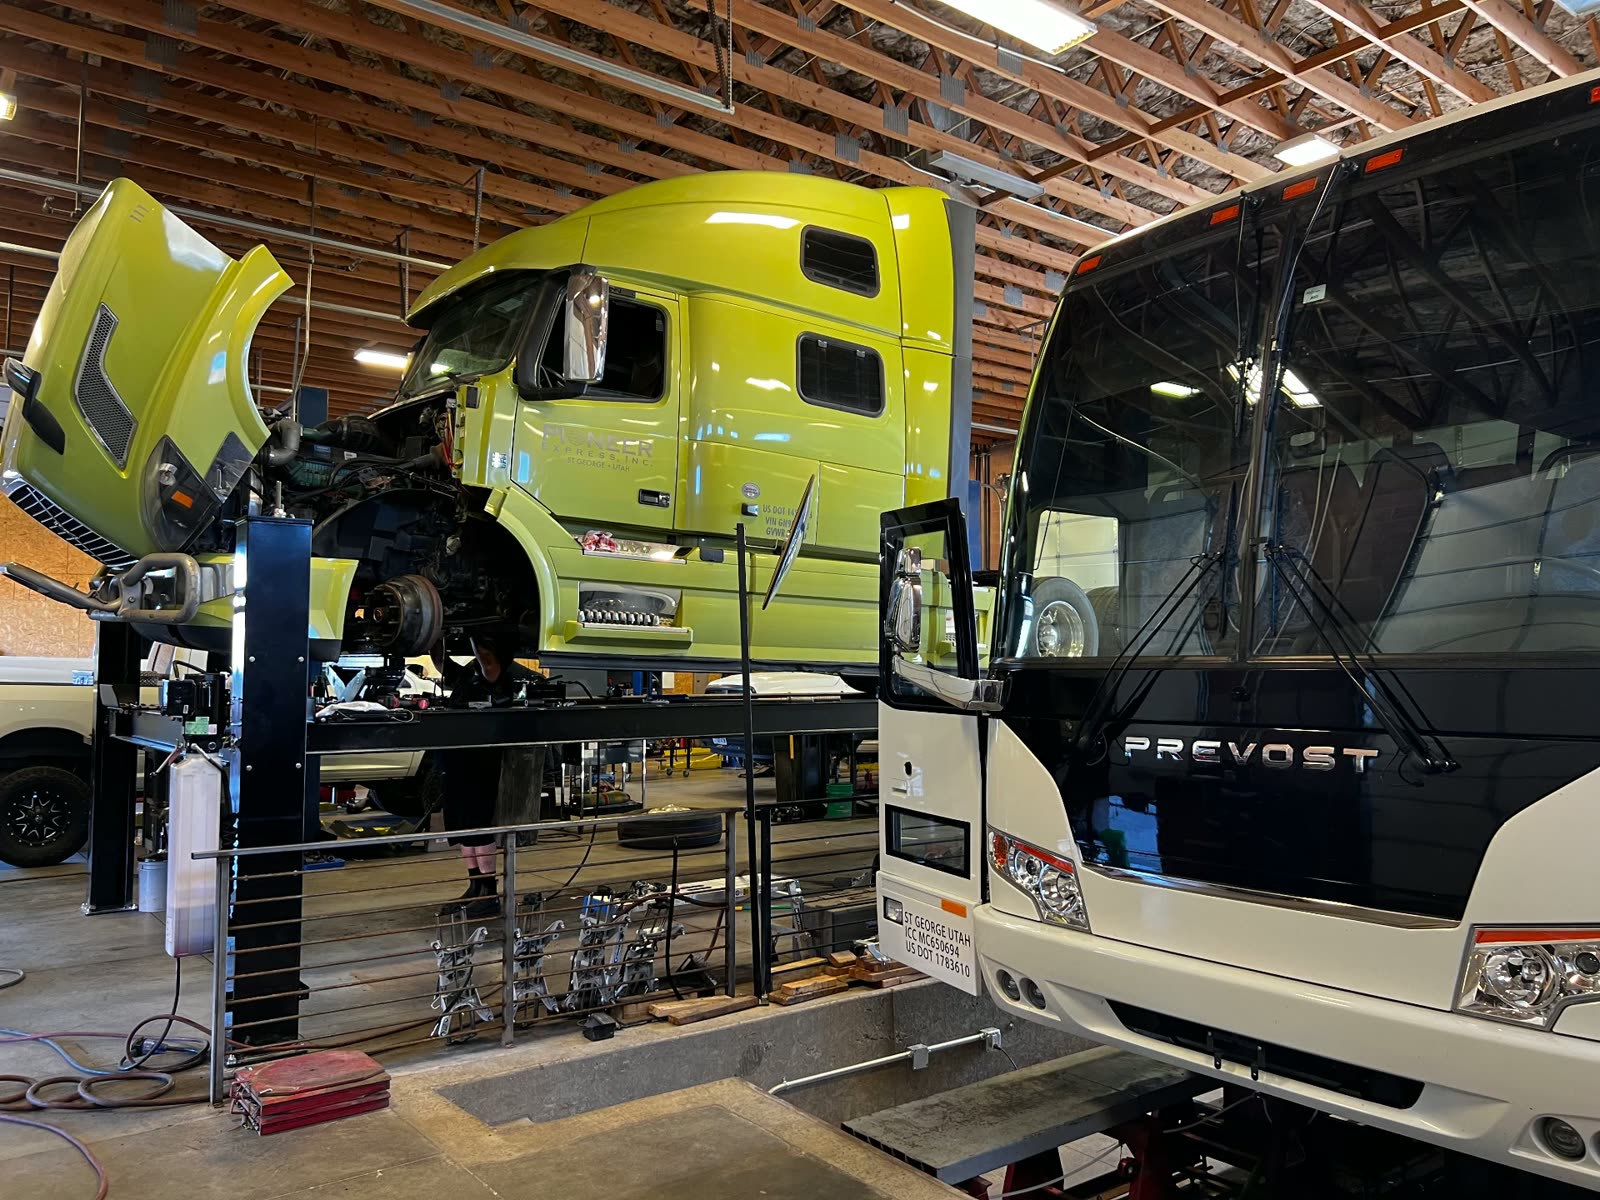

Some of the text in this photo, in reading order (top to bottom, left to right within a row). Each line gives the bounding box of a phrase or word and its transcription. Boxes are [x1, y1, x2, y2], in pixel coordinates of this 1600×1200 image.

[542, 424, 653, 458] PIONEER
[576, 458, 605, 469] GEORGE
[612, 464, 630, 472] UTAH
[625, 455, 654, 467] INC.
[763, 504, 771, 513] US
[773, 506, 786, 515] DOT
[766, 516, 776, 526] VIN
[766, 527, 785, 537] GVWR
[1124, 736, 1379, 773] PREVOST
[904, 911, 971, 947] ST GEORGE UTAH
[905, 926, 960, 958] ICC MC650694
[905, 940, 970, 978] US DOT 1783610
